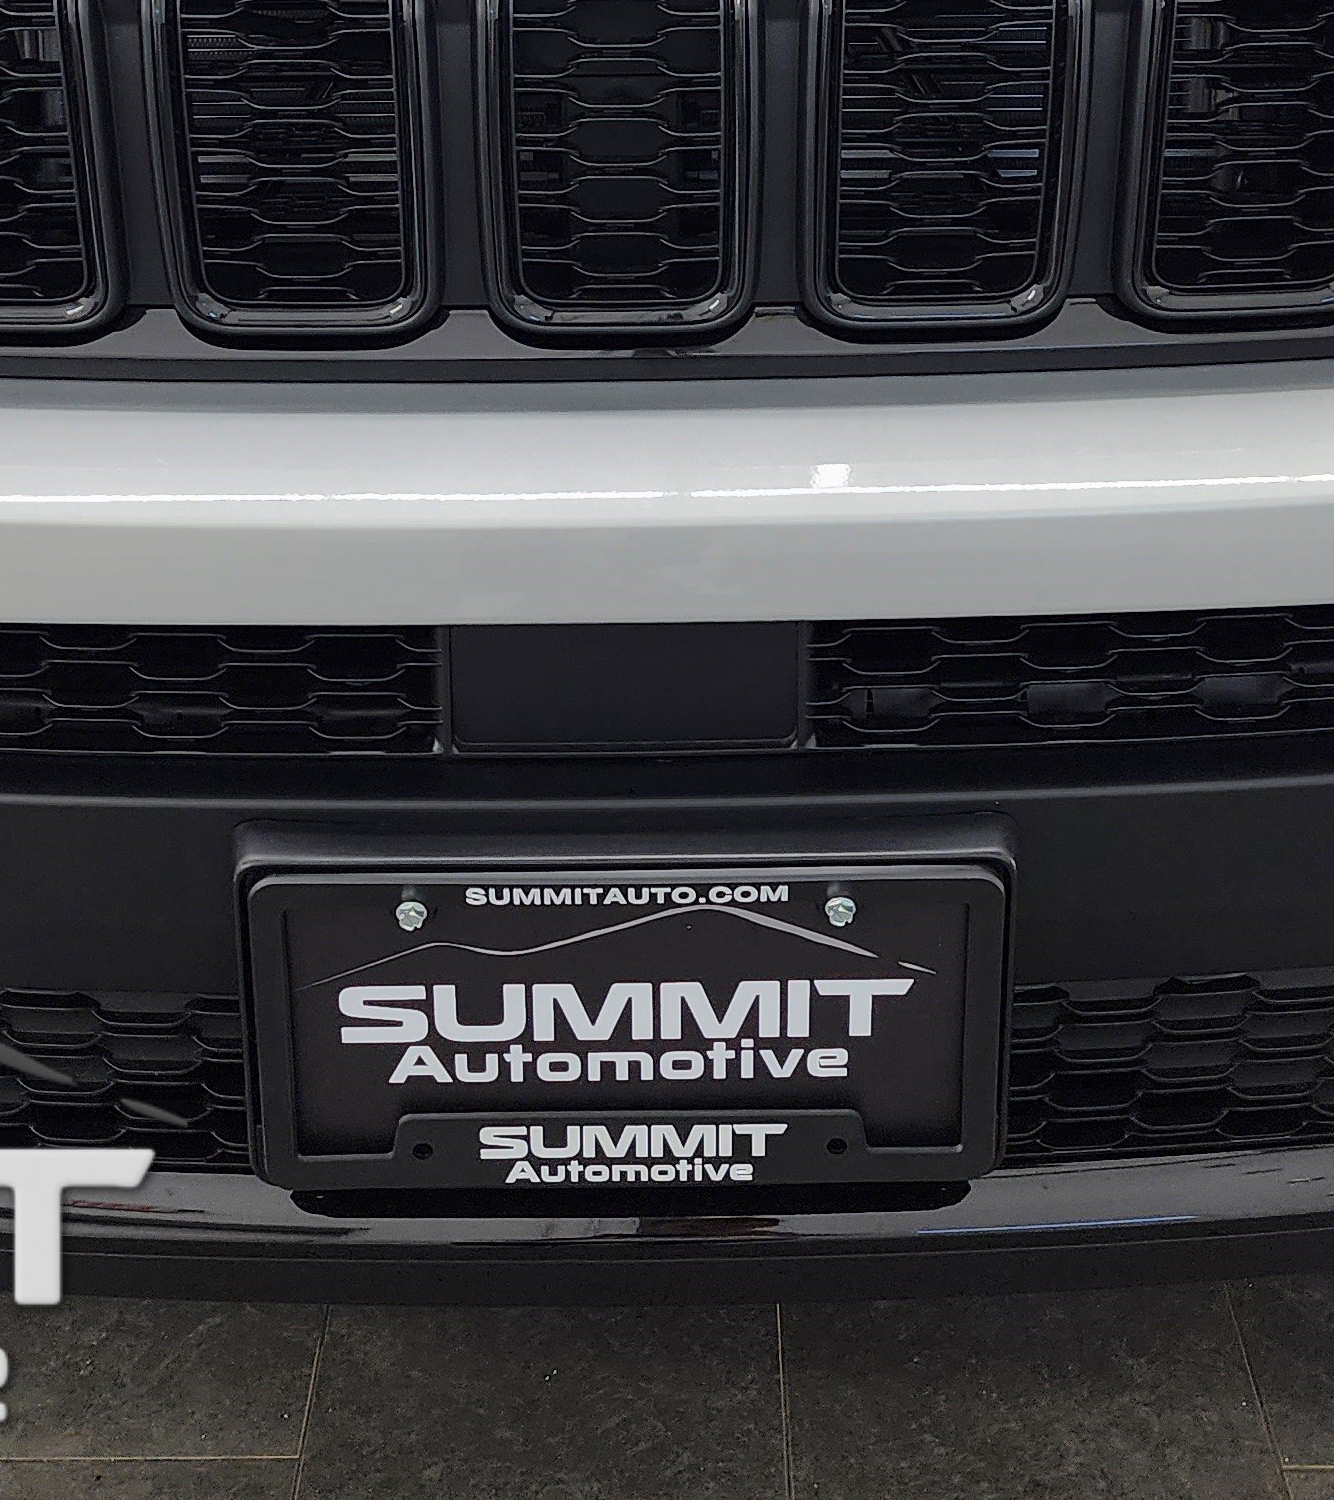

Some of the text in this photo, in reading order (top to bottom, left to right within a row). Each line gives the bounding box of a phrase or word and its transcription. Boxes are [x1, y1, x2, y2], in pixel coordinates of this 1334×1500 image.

[465, 884, 789, 906] SUMMITAUTO.COM
[338, 978, 915, 1044] SUMMIT
[388, 1038, 849, 1084] Automotive
[478, 1123, 789, 1160] SUMMIT
[504, 1157, 754, 1184] Automotive
